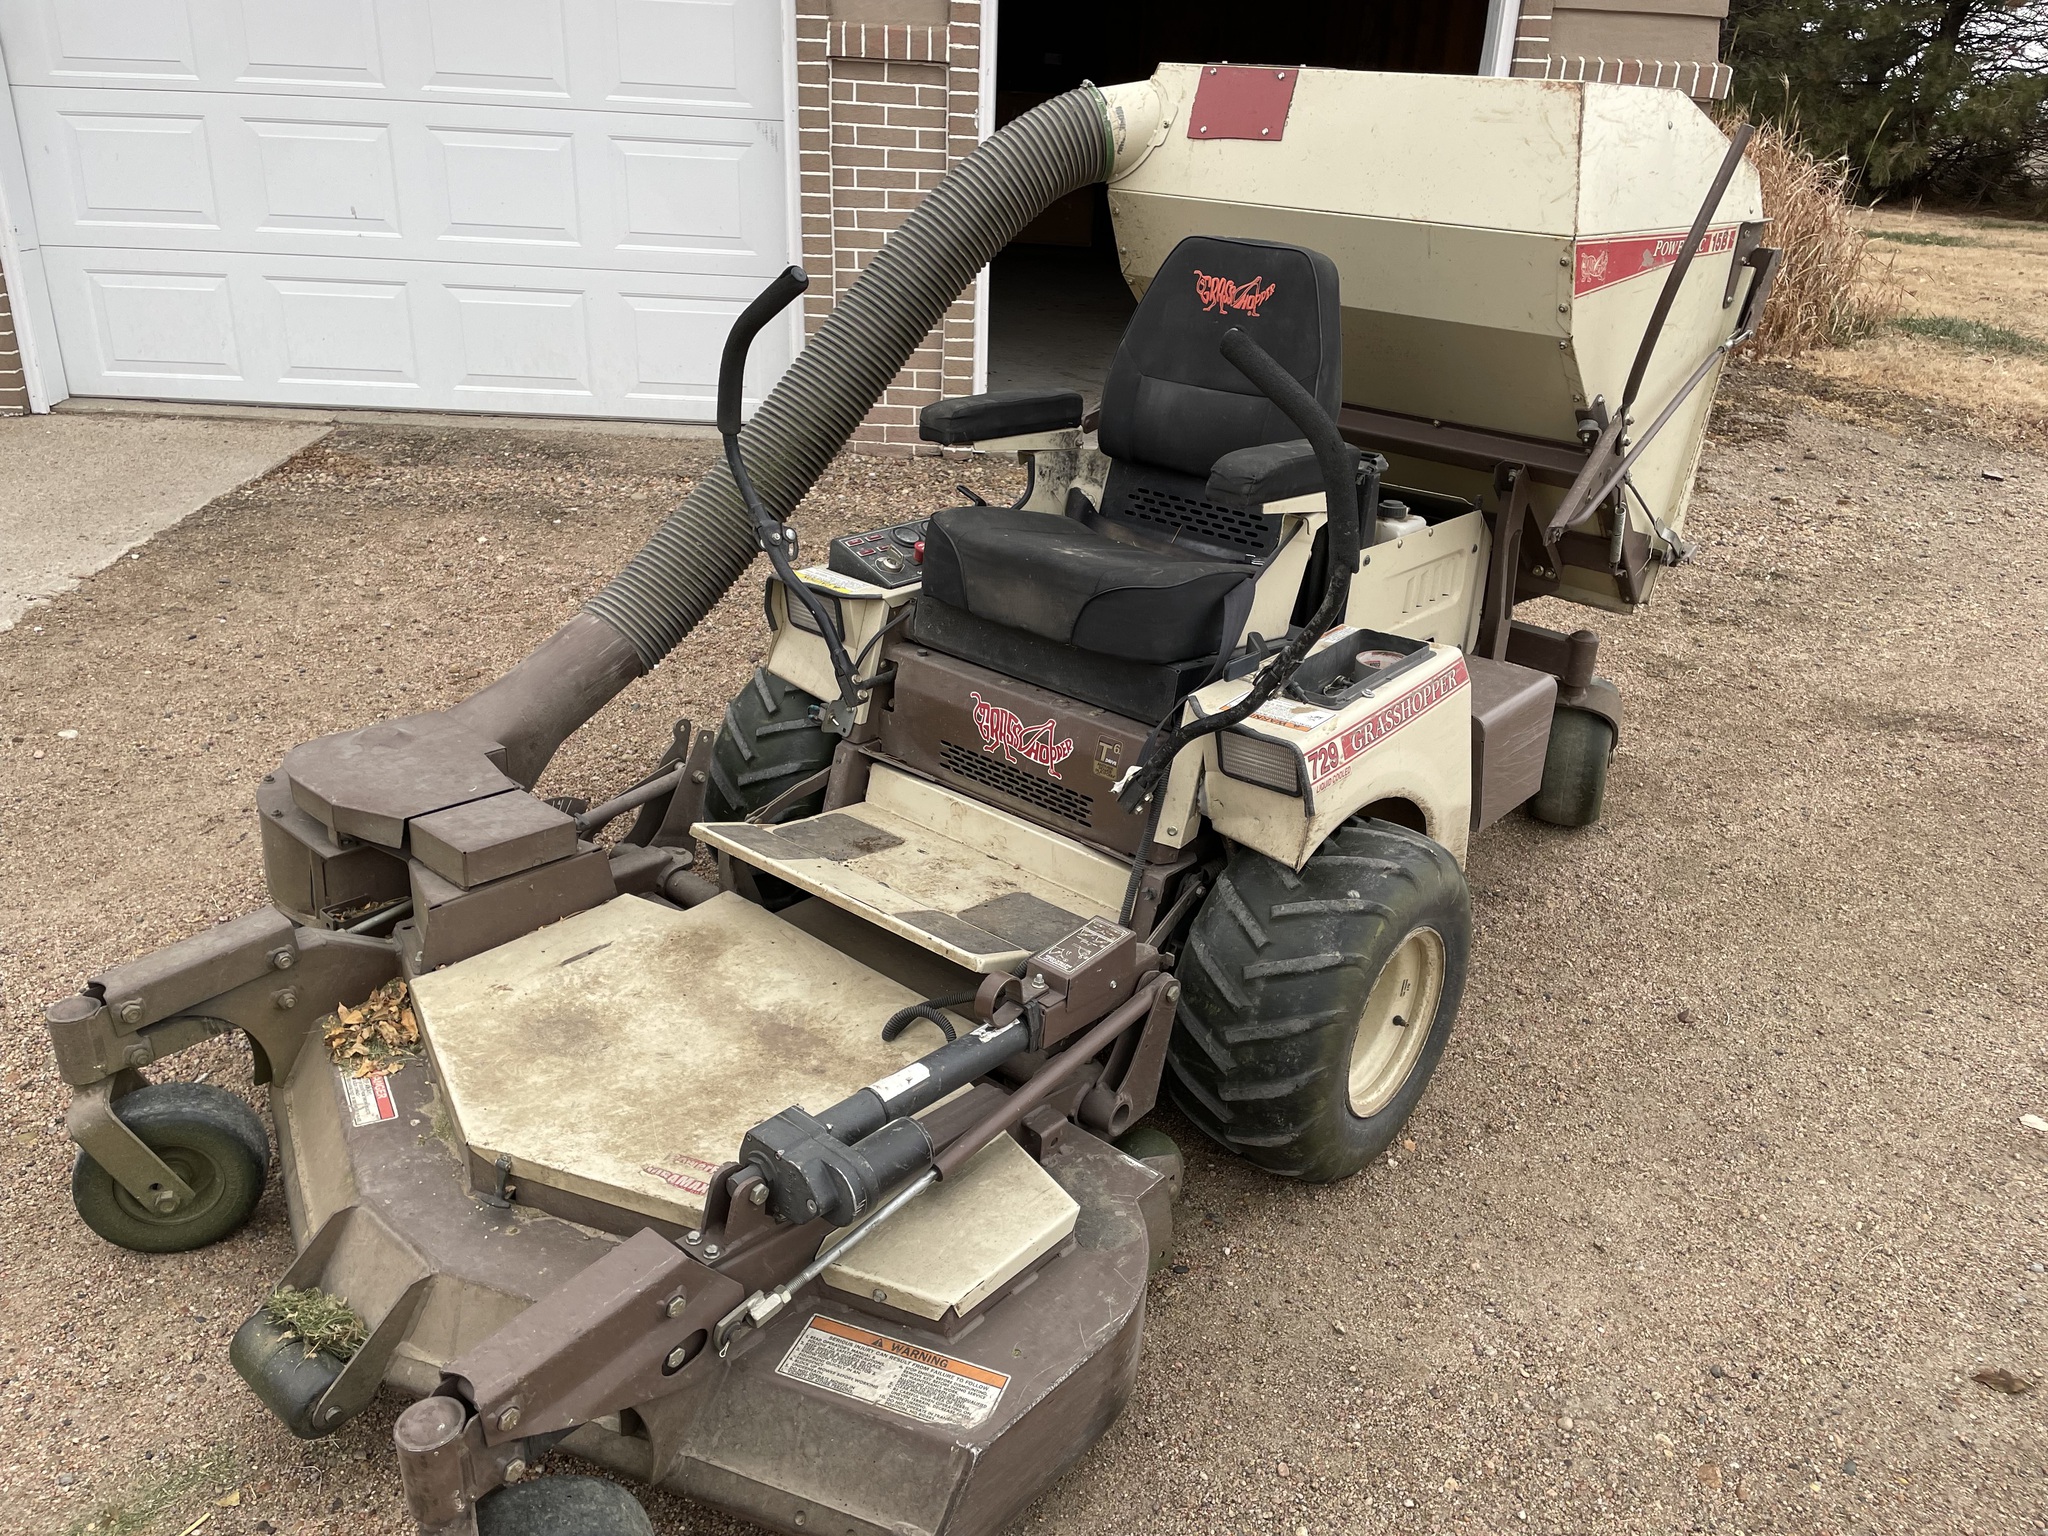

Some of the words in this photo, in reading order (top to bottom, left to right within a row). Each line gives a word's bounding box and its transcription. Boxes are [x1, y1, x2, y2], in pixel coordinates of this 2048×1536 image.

[1307, 741, 1340, 781] 729
[1350, 667, 1458, 752] GRASSHOPPER
[1315, 775, 1332, 794] LIQUID
[1331, 765, 1352, 785] COOLED
[828, 1336, 854, 1347] SERIOUS
[854, 1344, 875, 1353] INJURY
[889, 1355, 911, 1366] RESULT
[911, 1363, 930, 1371] FROM
[930, 1369, 955, 1379] FAILURE
[891, 1342, 949, 1368] WARNING
